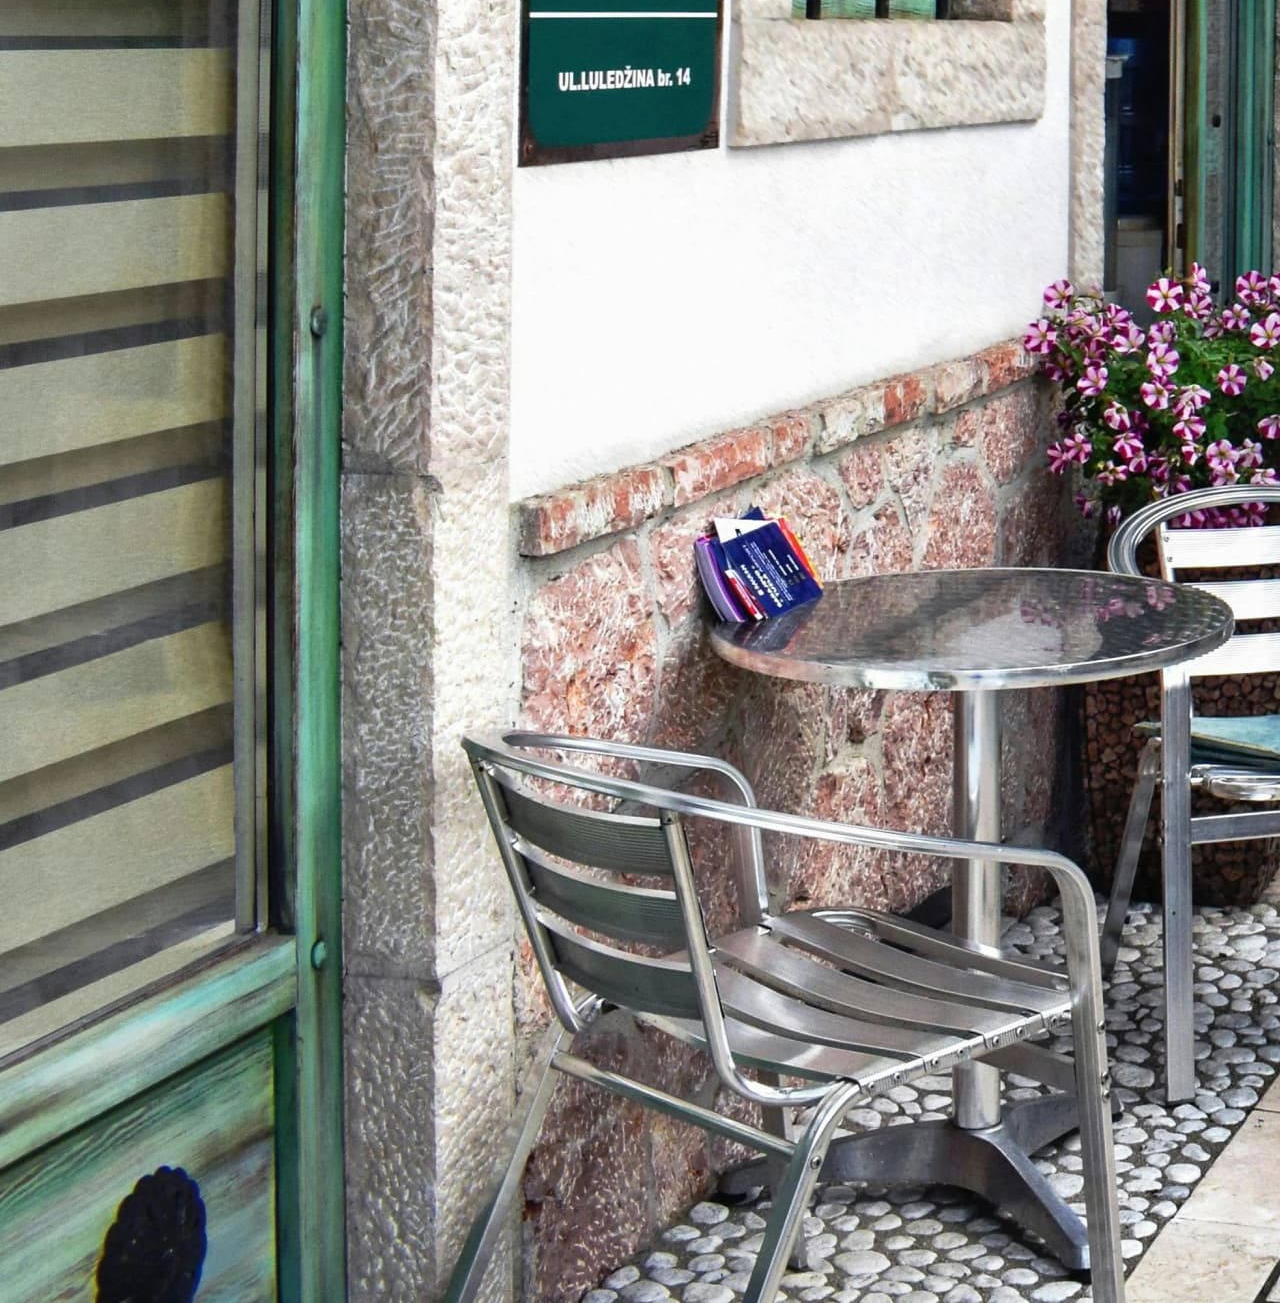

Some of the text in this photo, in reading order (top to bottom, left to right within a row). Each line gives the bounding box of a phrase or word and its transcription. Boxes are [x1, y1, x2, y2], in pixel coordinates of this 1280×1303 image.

[558, 65, 691, 92] UL.LULEDŽINA br. 14
